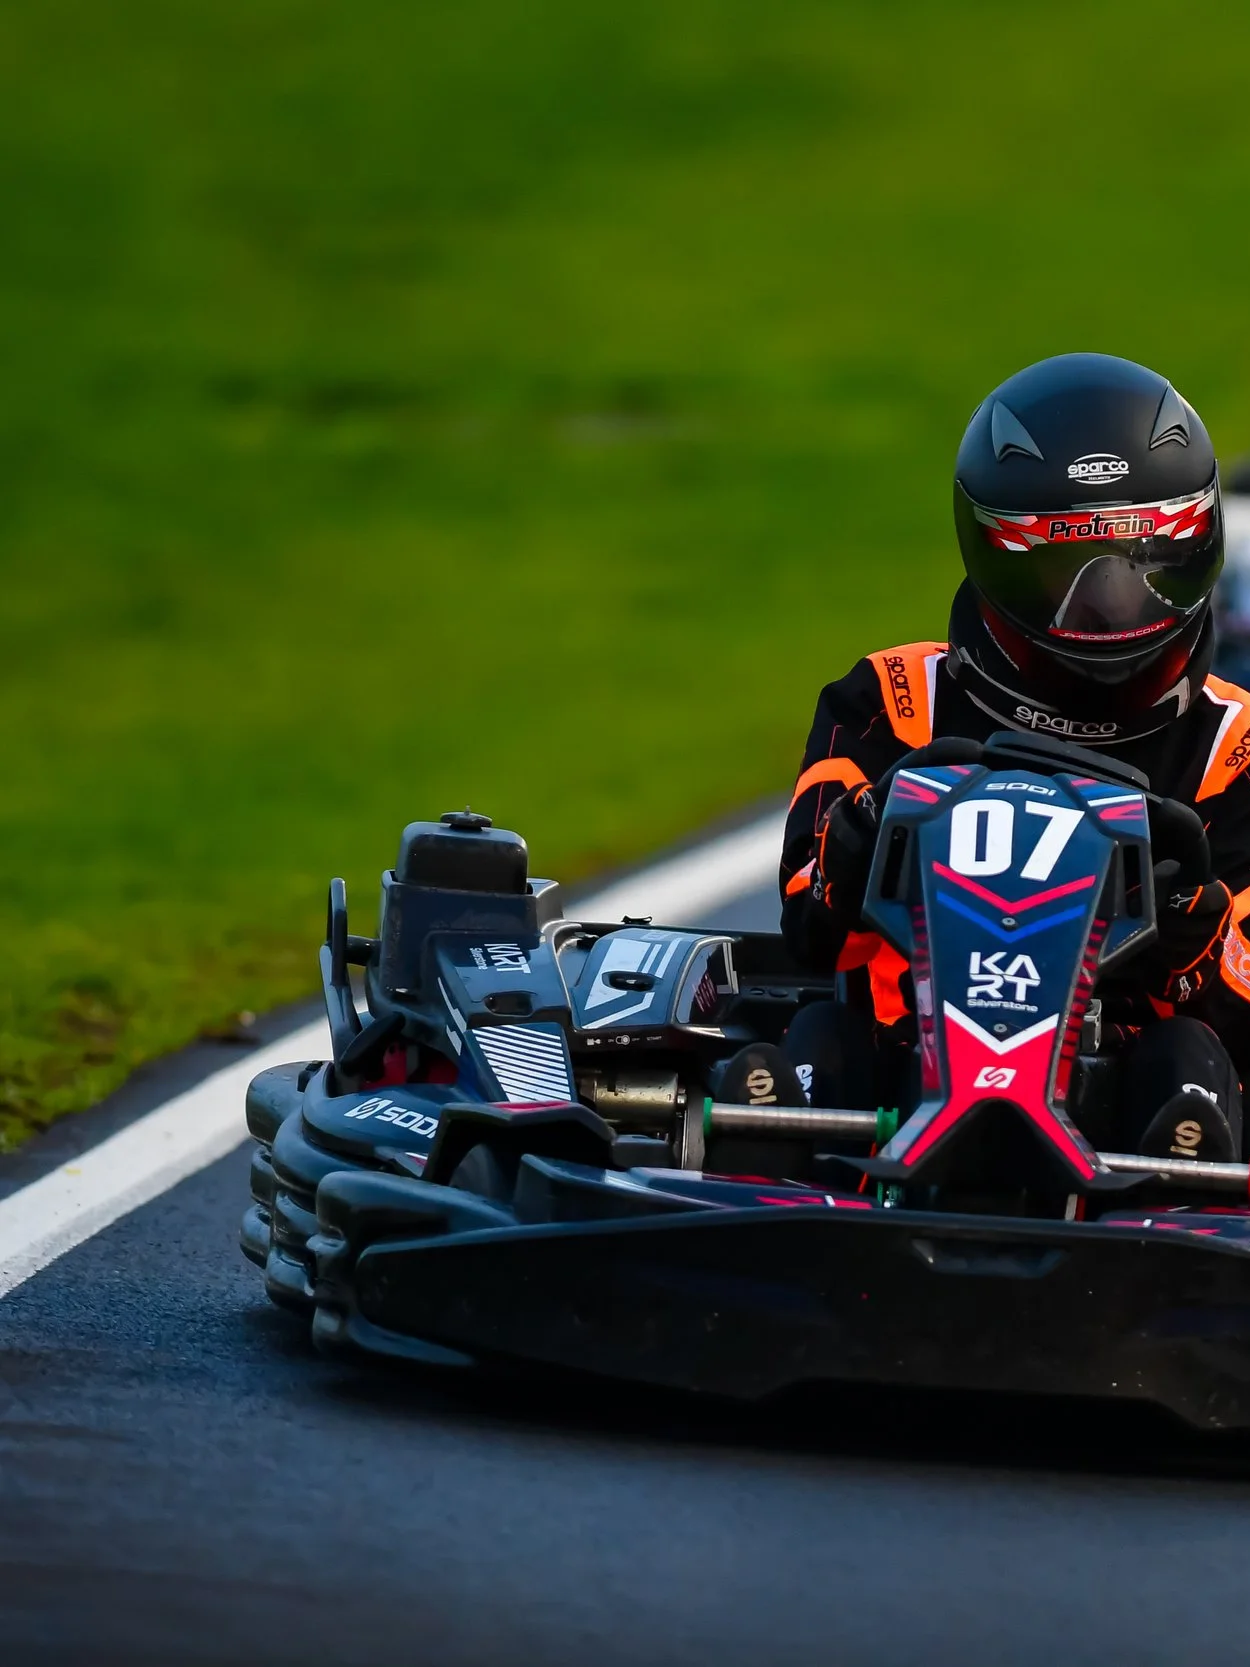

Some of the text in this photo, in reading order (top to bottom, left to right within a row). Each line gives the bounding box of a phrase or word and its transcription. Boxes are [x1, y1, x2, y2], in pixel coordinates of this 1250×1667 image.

[1049, 513, 1154, 540] Protrain
[883, 656, 915, 718] sparco
[1013, 705, 1118, 738] sparco
[985, 786, 1057, 796] SODI
[949, 799, 1086, 881] 07
[967, 998, 1039, 1013] Silverstone
